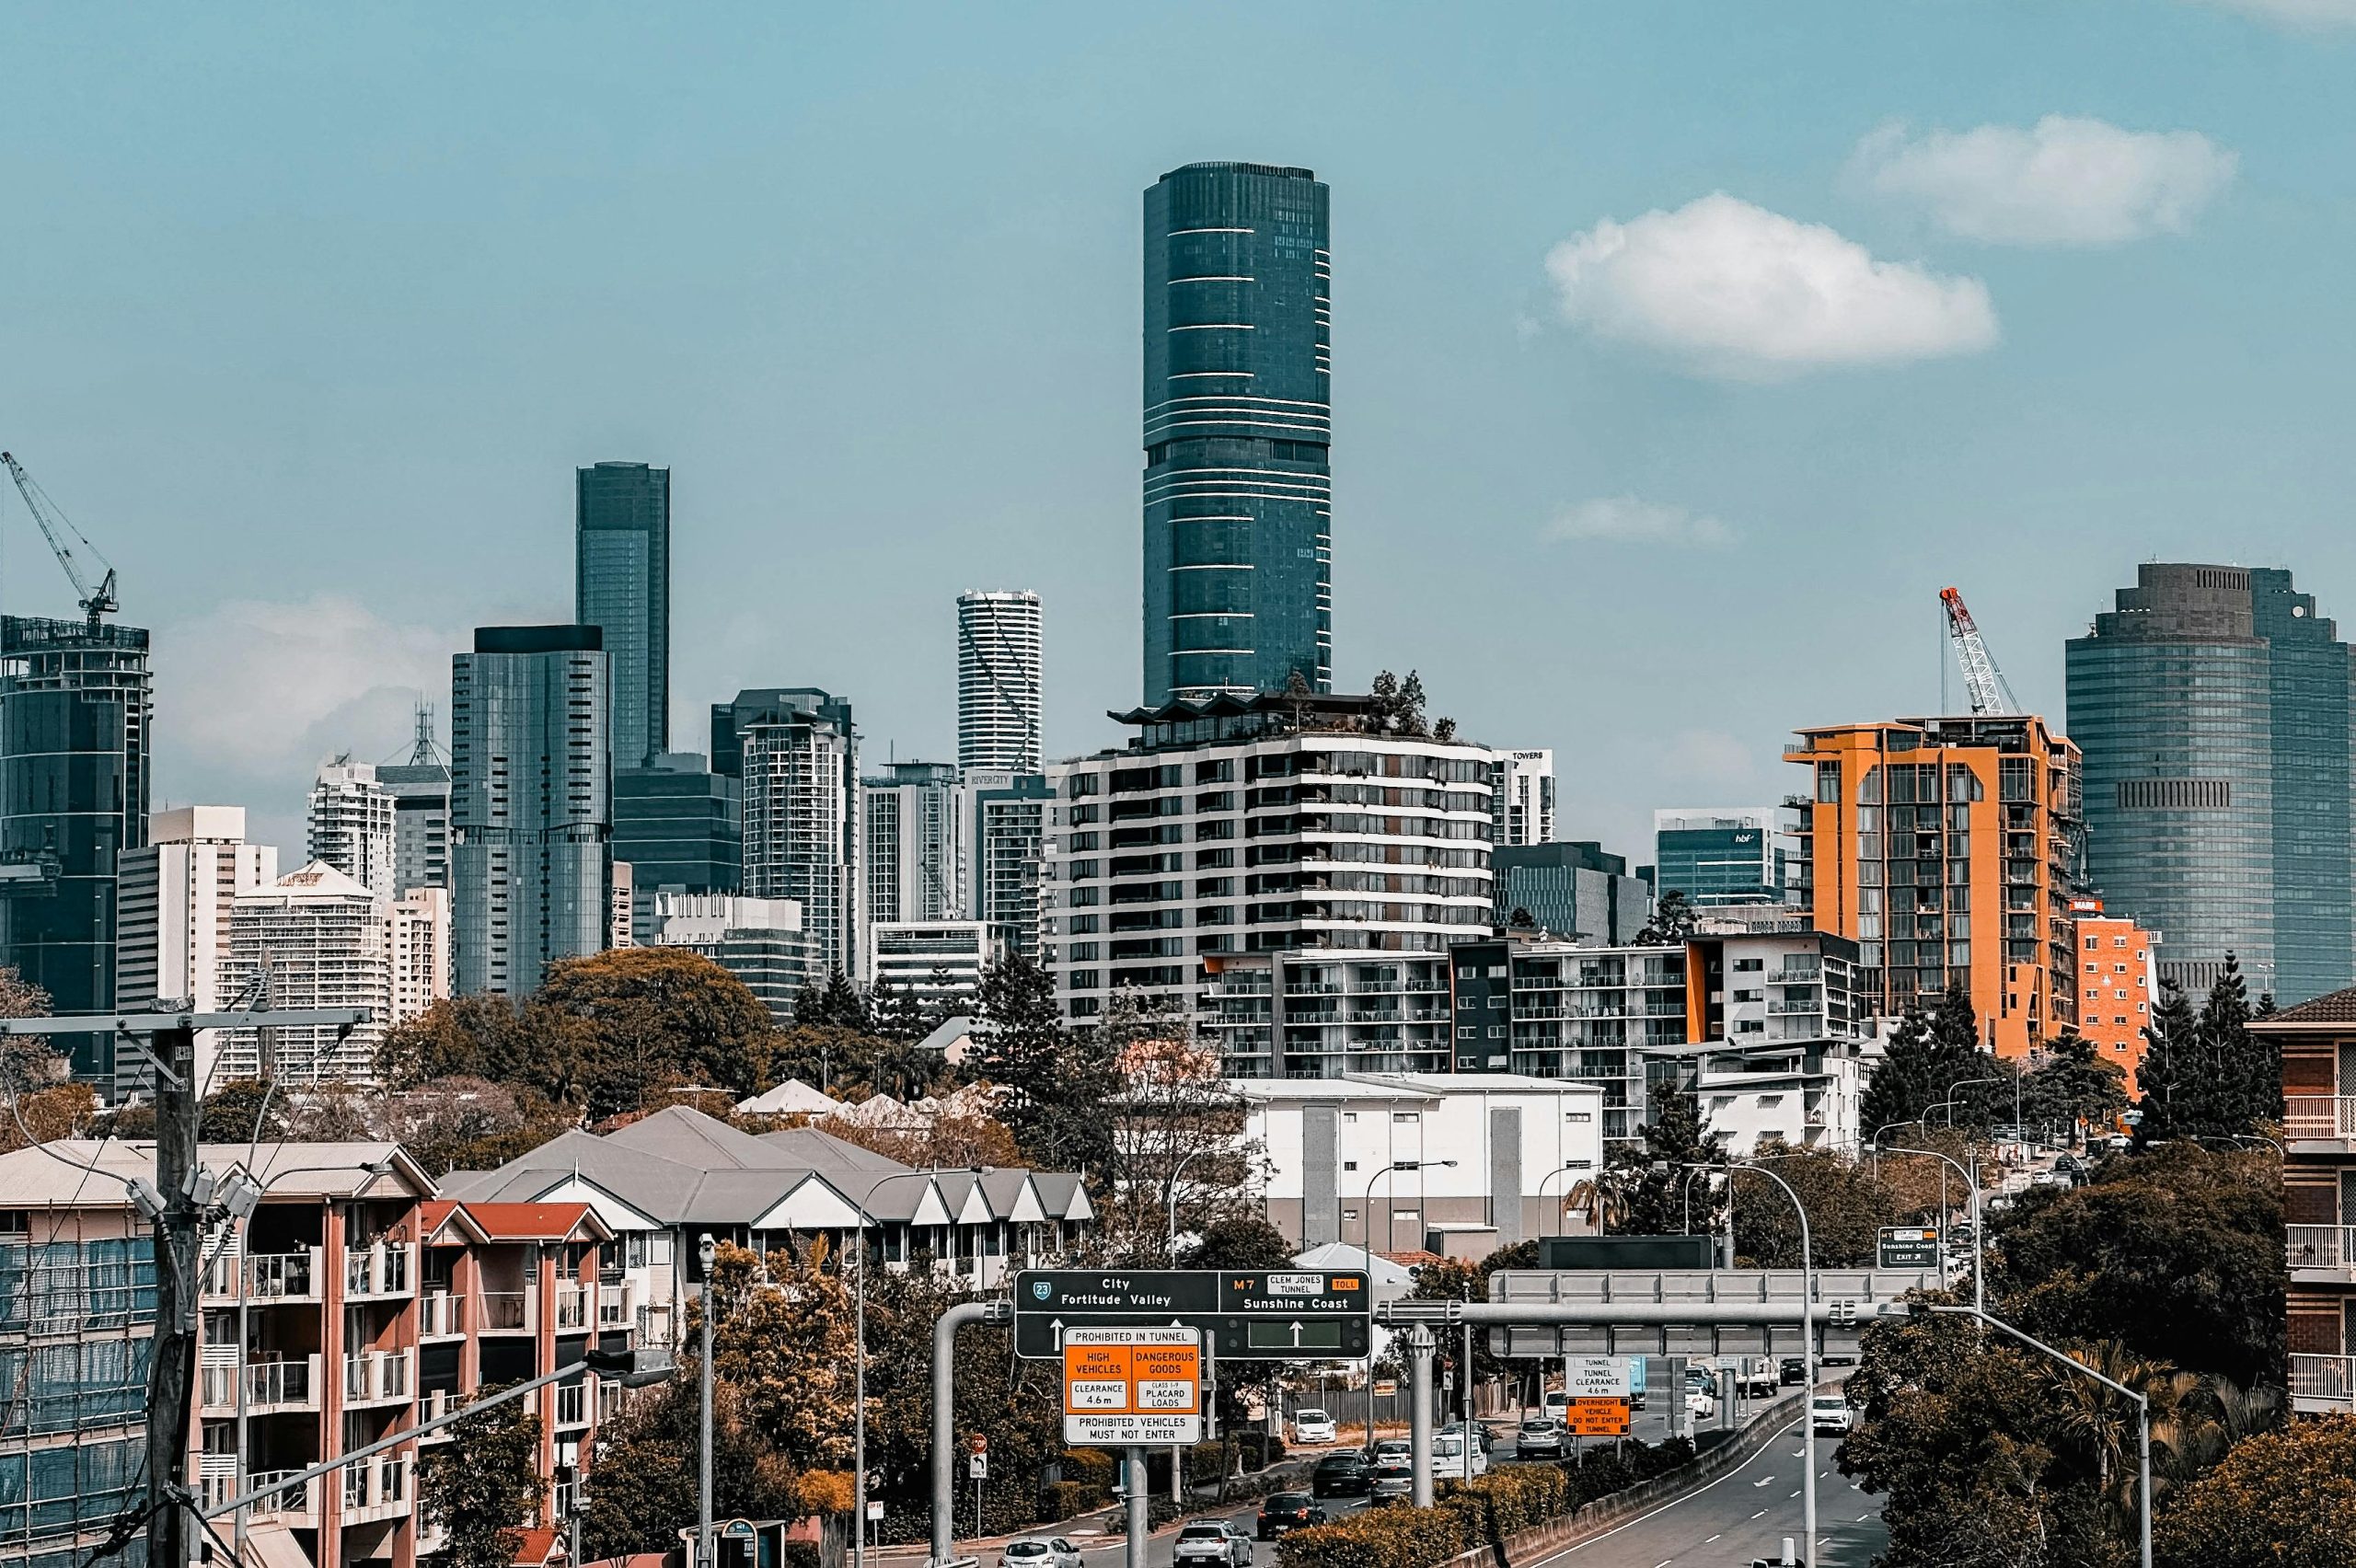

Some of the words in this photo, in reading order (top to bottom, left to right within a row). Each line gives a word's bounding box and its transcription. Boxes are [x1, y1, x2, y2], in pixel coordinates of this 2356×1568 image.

[1513, 752, 1543, 760] TOWERS
[1735, 834, 1751, 843] hbf
[1103, 1278, 1130, 1291] City
[1036, 1285, 1048, 1295] 23
[1280, 1286, 1311, 1294] TUNNEL
[1061, 1294, 1121, 1305] Fortitude
[1130, 1294, 1172, 1308] Valley
[1243, 1298, 1305, 1309] Sunshine
[1311, 1298, 1348, 1309] Coast
[1075, 1332, 1132, 1343] PROHIBITED
[1136, 1332, 1146, 1342] IN
[1149, 1332, 1187, 1342] TUNNEL
[1087, 1353, 1110, 1362] HIGH
[1136, 1352, 1195, 1362] DANGEROUS
[1076, 1365, 1122, 1374] VEHICLES
[1149, 1365, 1182, 1374] GOODS
[1584, 1369, 1612, 1378] TUNNEL
[1074, 1385, 1123, 1393] CLEARANCE
[1146, 1389, 1185, 1398] PLACARD
[1086, 1395, 1102, 1404] 4.6
[1151, 1399, 1179, 1407] LOADS
[1079, 1418, 1134, 1427] PROHIBITED
[1140, 1418, 1186, 1427] VEHICLES
[1090, 1430, 1115, 1439] MUST
[1121, 1430, 1139, 1439] NOT
[1146, 1430, 1175, 1439] ENTER
